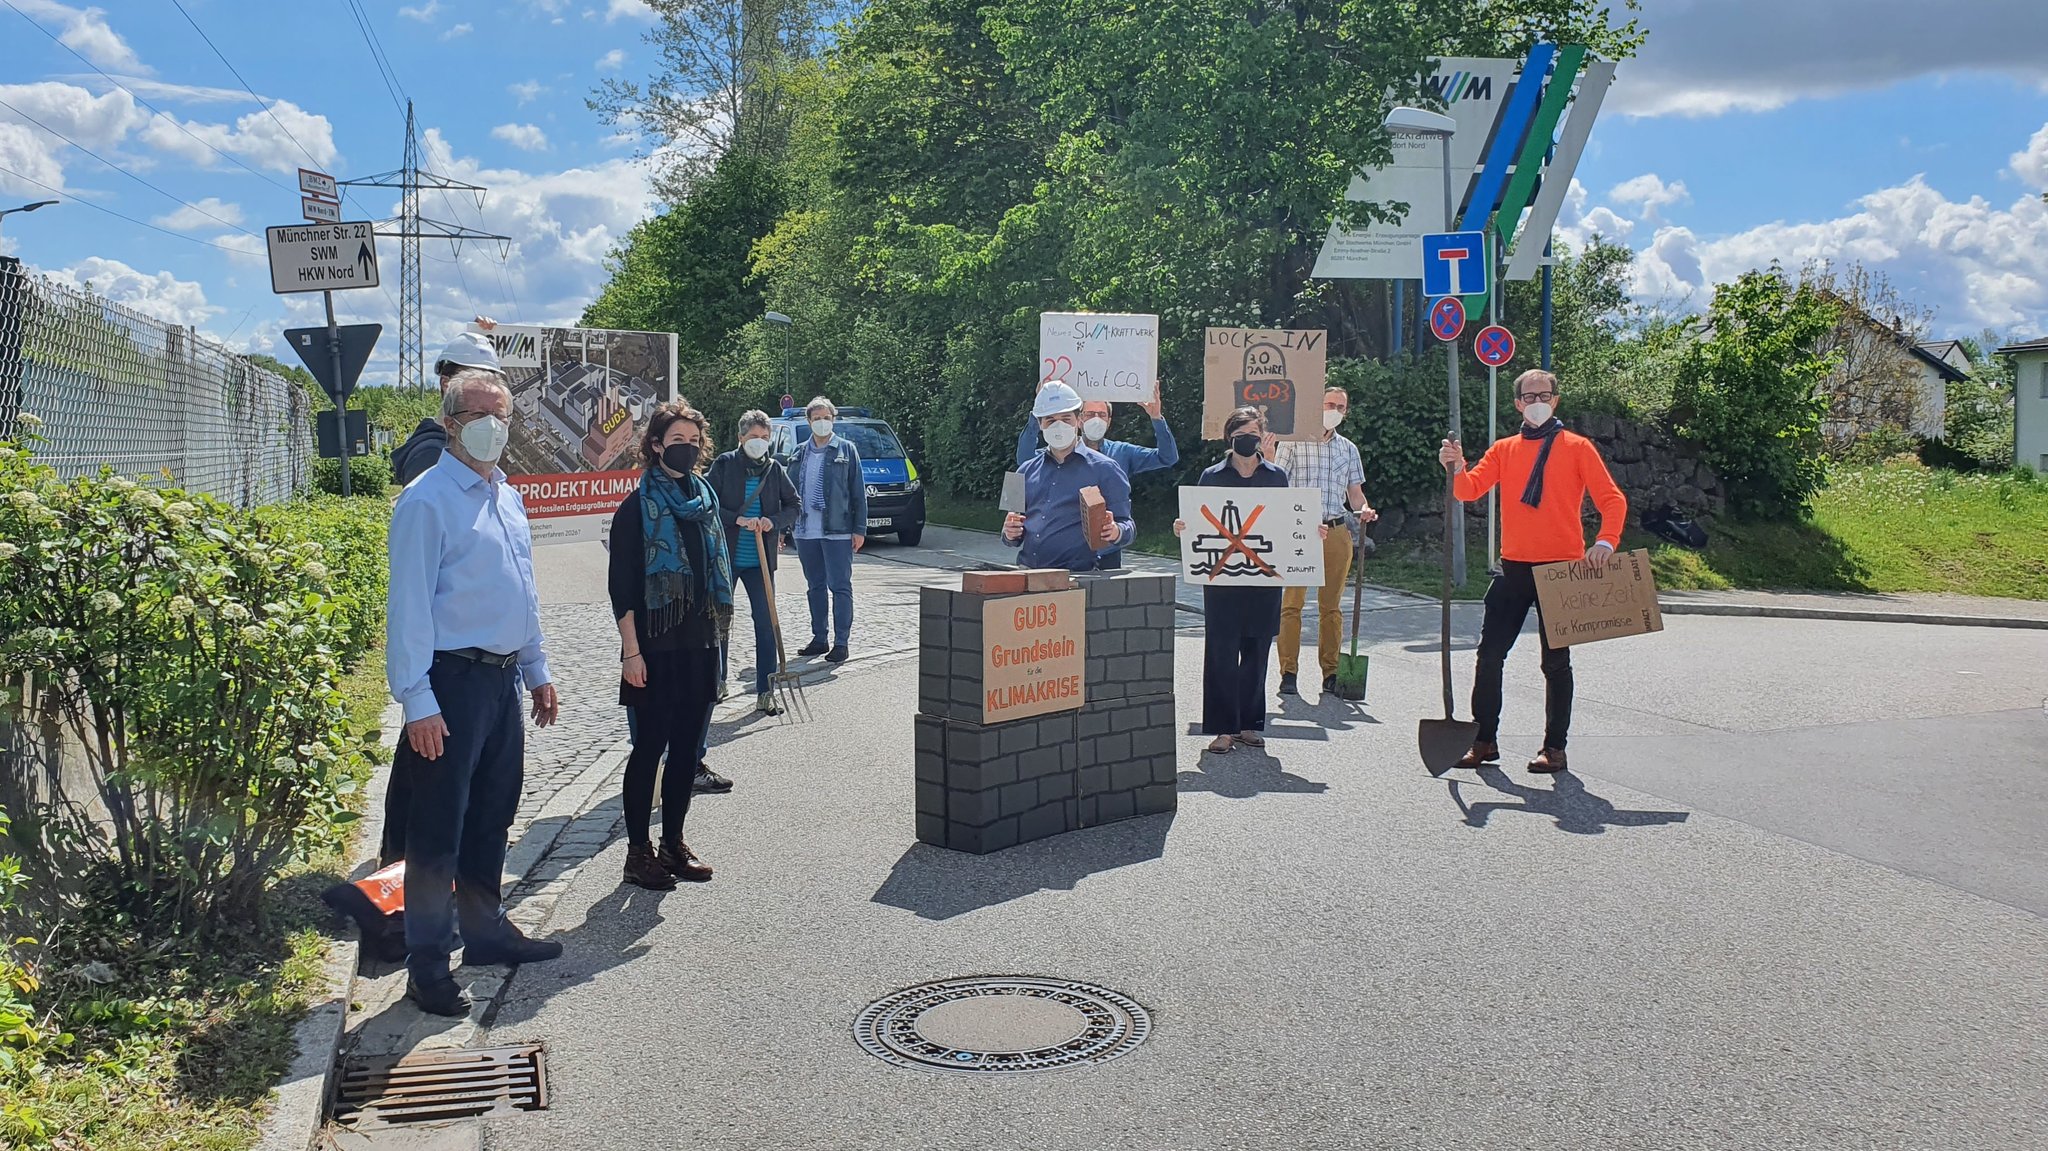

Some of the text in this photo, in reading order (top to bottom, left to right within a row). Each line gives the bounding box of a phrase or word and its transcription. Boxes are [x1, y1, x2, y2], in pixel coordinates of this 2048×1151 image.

[277, 225, 366, 244] Münchner Str. 22
[311, 245, 338, 261] SWM
[298, 265, 354, 281] HKW Nord
[1249, 352, 1270, 364] 30
[1247, 365, 1283, 375] JAHRE
[603, 408, 626, 434] GUD3
[540, 503, 565, 513] fossilen
[566, 500, 622, 513] Erdgasgroßkraftw
[1292, 532, 1306, 540] Gas
[1568, 561, 1603, 581] Klima
[1608, 558, 1622, 571] hat
[1560, 582, 1639, 610] keine Zeit
[1014, 603, 1057, 631] GUD3
[1555, 616, 1632, 636] für Kompromisse
[991, 635, 1075, 668] Grundstein
[987, 675, 1080, 712] KLIMAKRISE
